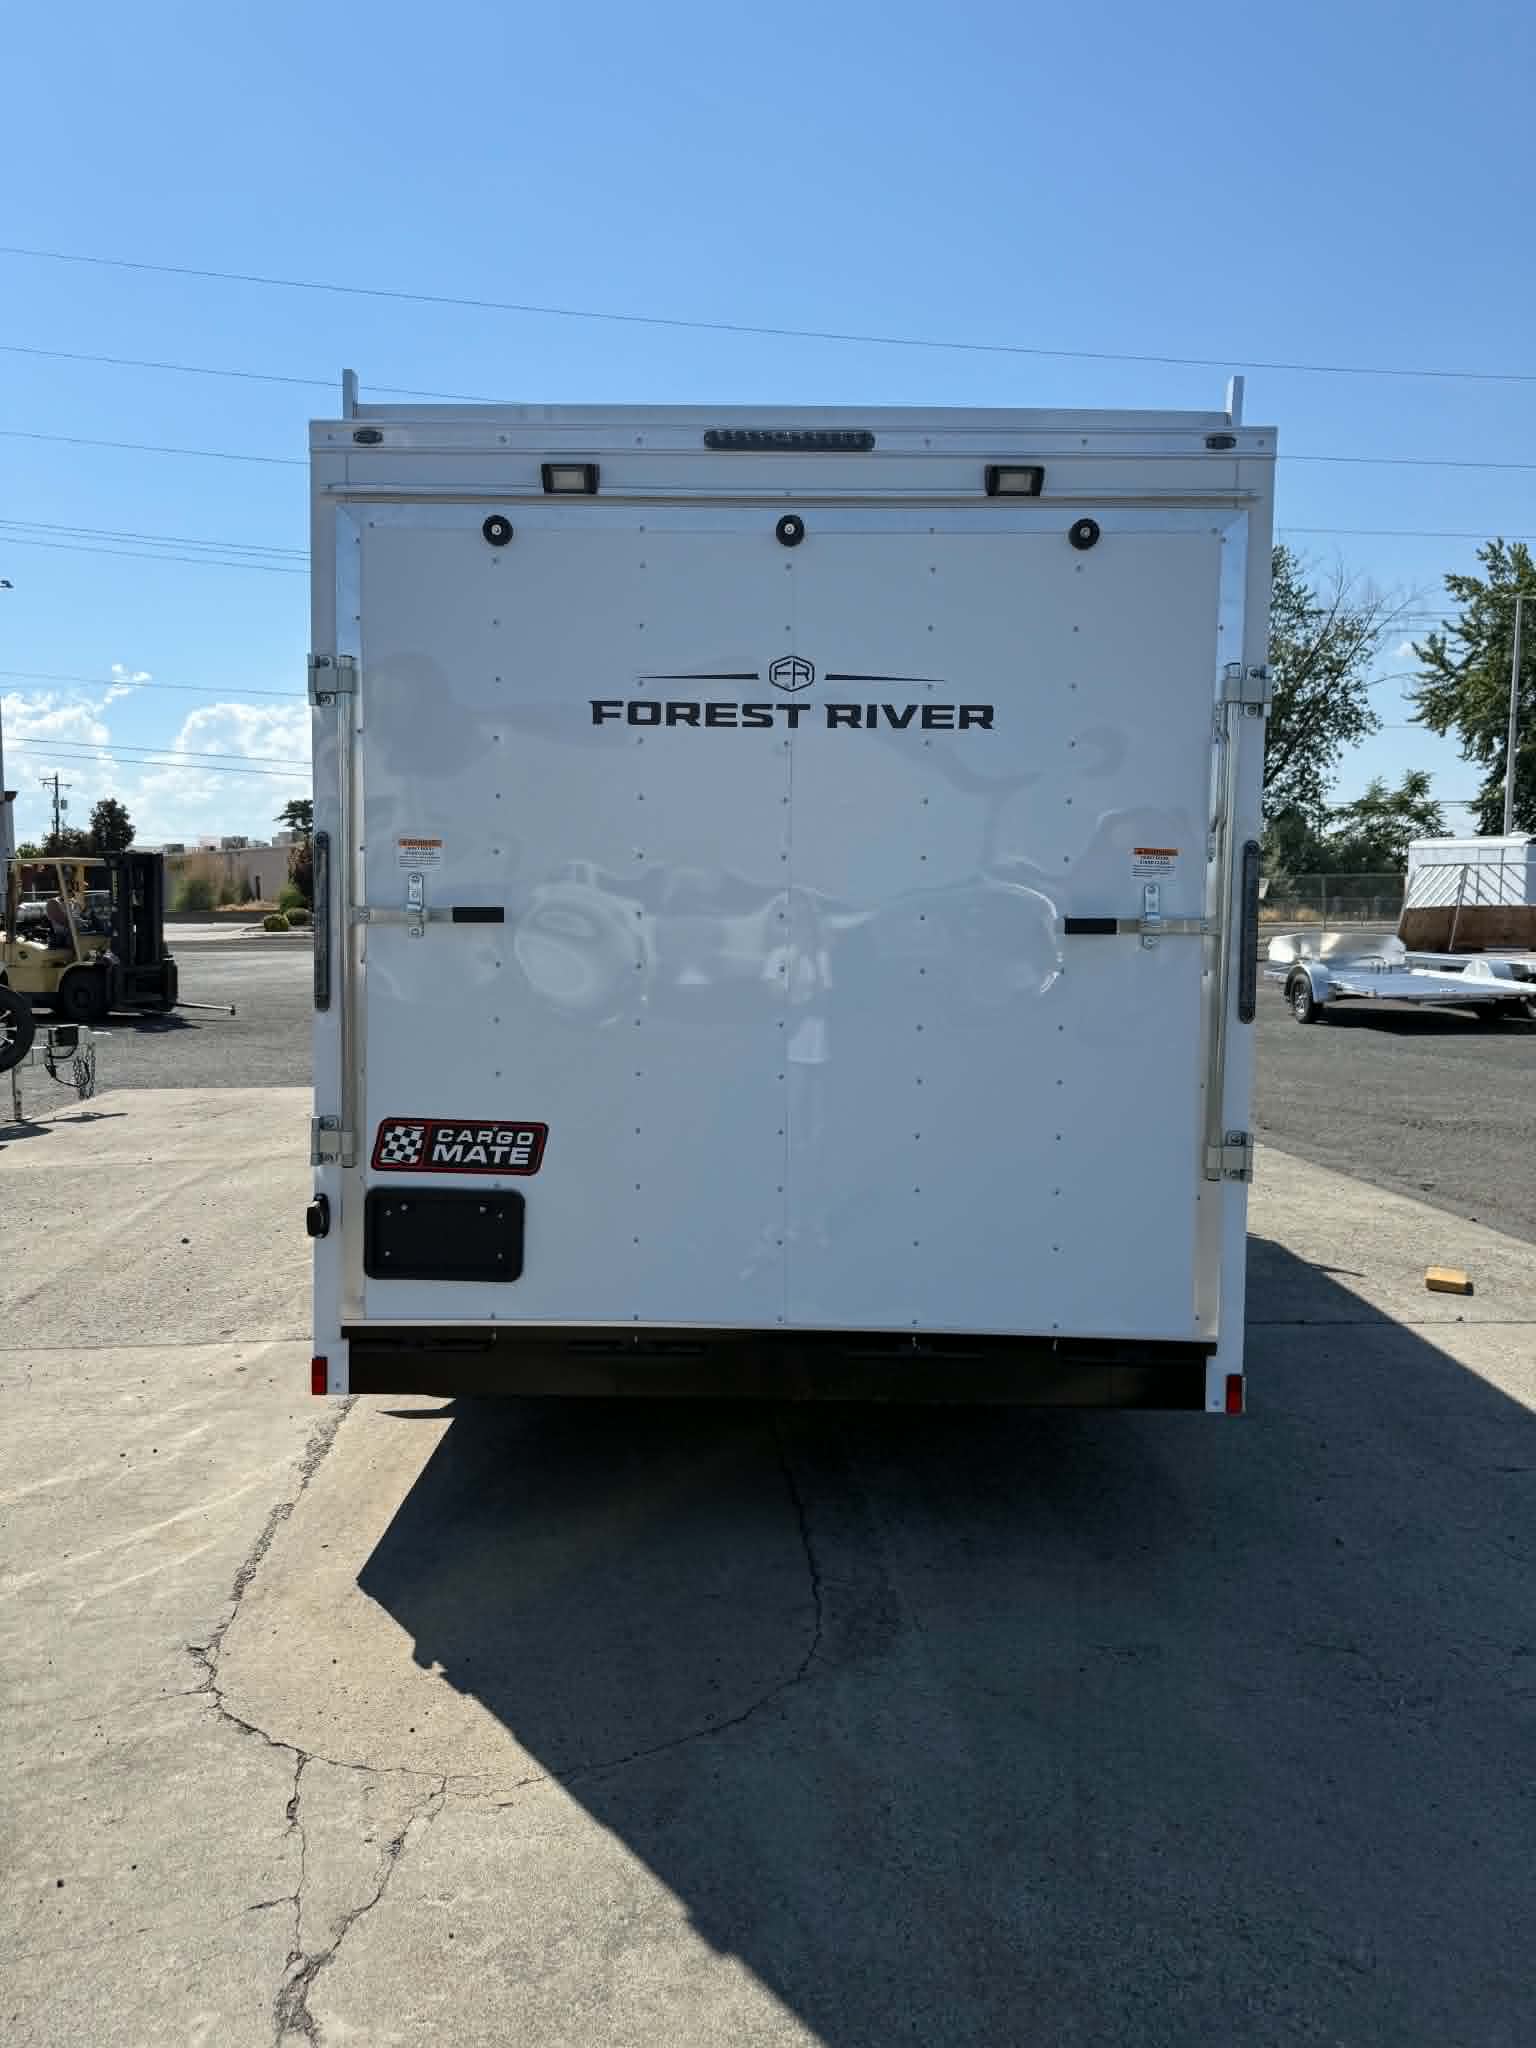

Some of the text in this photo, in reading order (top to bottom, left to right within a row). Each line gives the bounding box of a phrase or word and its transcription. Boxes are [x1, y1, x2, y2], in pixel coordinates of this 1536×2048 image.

[588, 701, 994, 730] FOREST RIVER
[437, 1129, 534, 1145] CARGO
[431, 1144, 532, 1165] MATE
